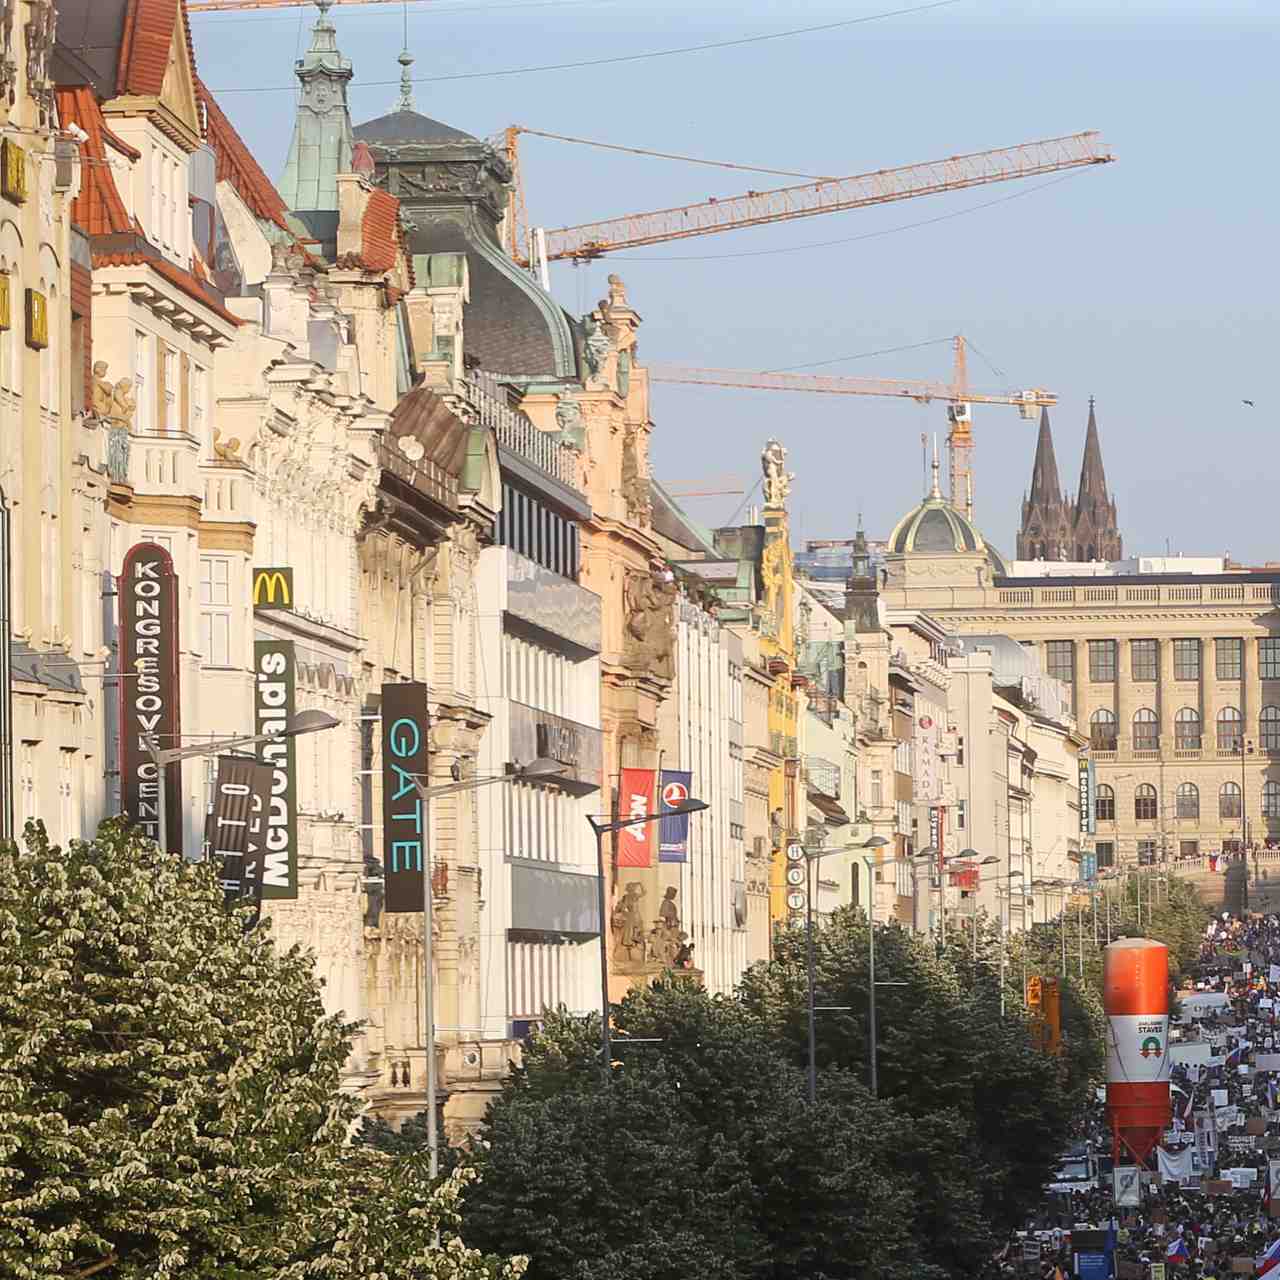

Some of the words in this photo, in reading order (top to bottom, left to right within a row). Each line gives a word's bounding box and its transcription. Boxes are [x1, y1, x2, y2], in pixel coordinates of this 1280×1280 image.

[138, 763, 160, 840] CENT
[258, 652, 289, 887] McDonald's
[390, 718, 421, 873] GATE
